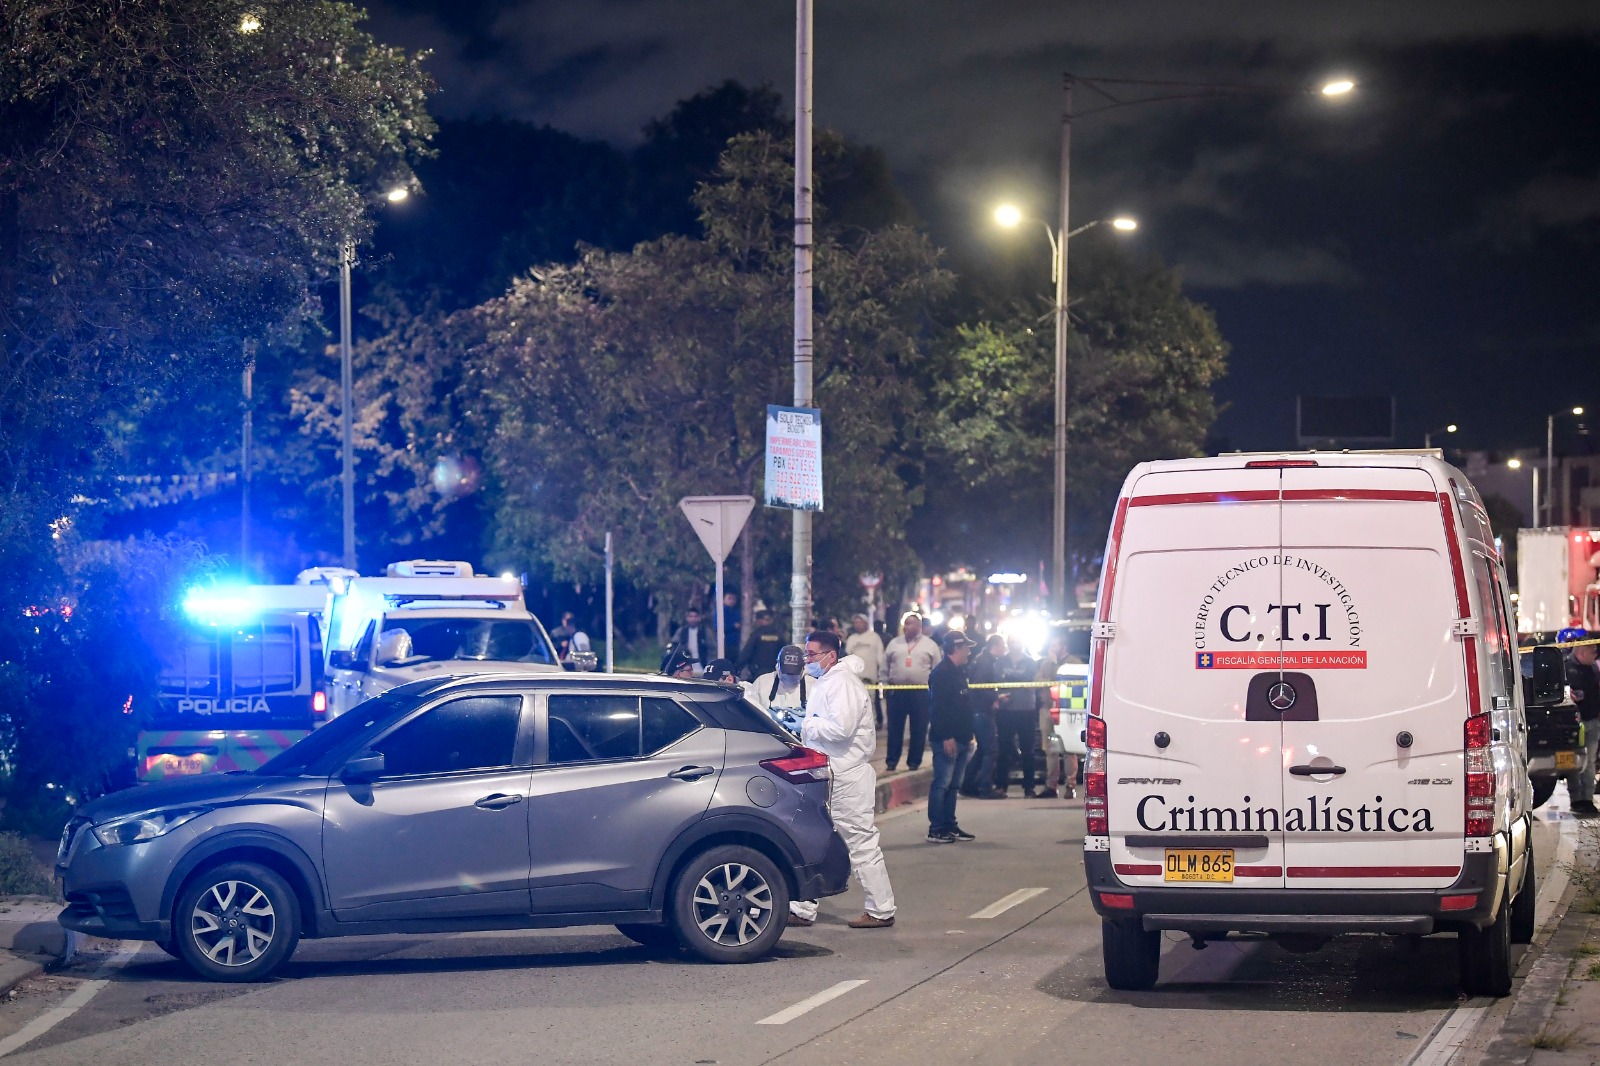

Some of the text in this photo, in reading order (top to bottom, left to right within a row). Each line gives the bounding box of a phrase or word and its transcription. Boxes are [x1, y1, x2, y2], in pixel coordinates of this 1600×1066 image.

[774, 456, 786, 468] PBX
[1194, 555, 1363, 649] CUERPO TÉCNICO DE INVESTIGACIÓN
[1216, 654, 1364, 664] FISCALÍA GENERAL DE LA NACIÓN
[1136, 794, 1434, 832] Criminalística
[1202, 854, 1232, 872] 865
